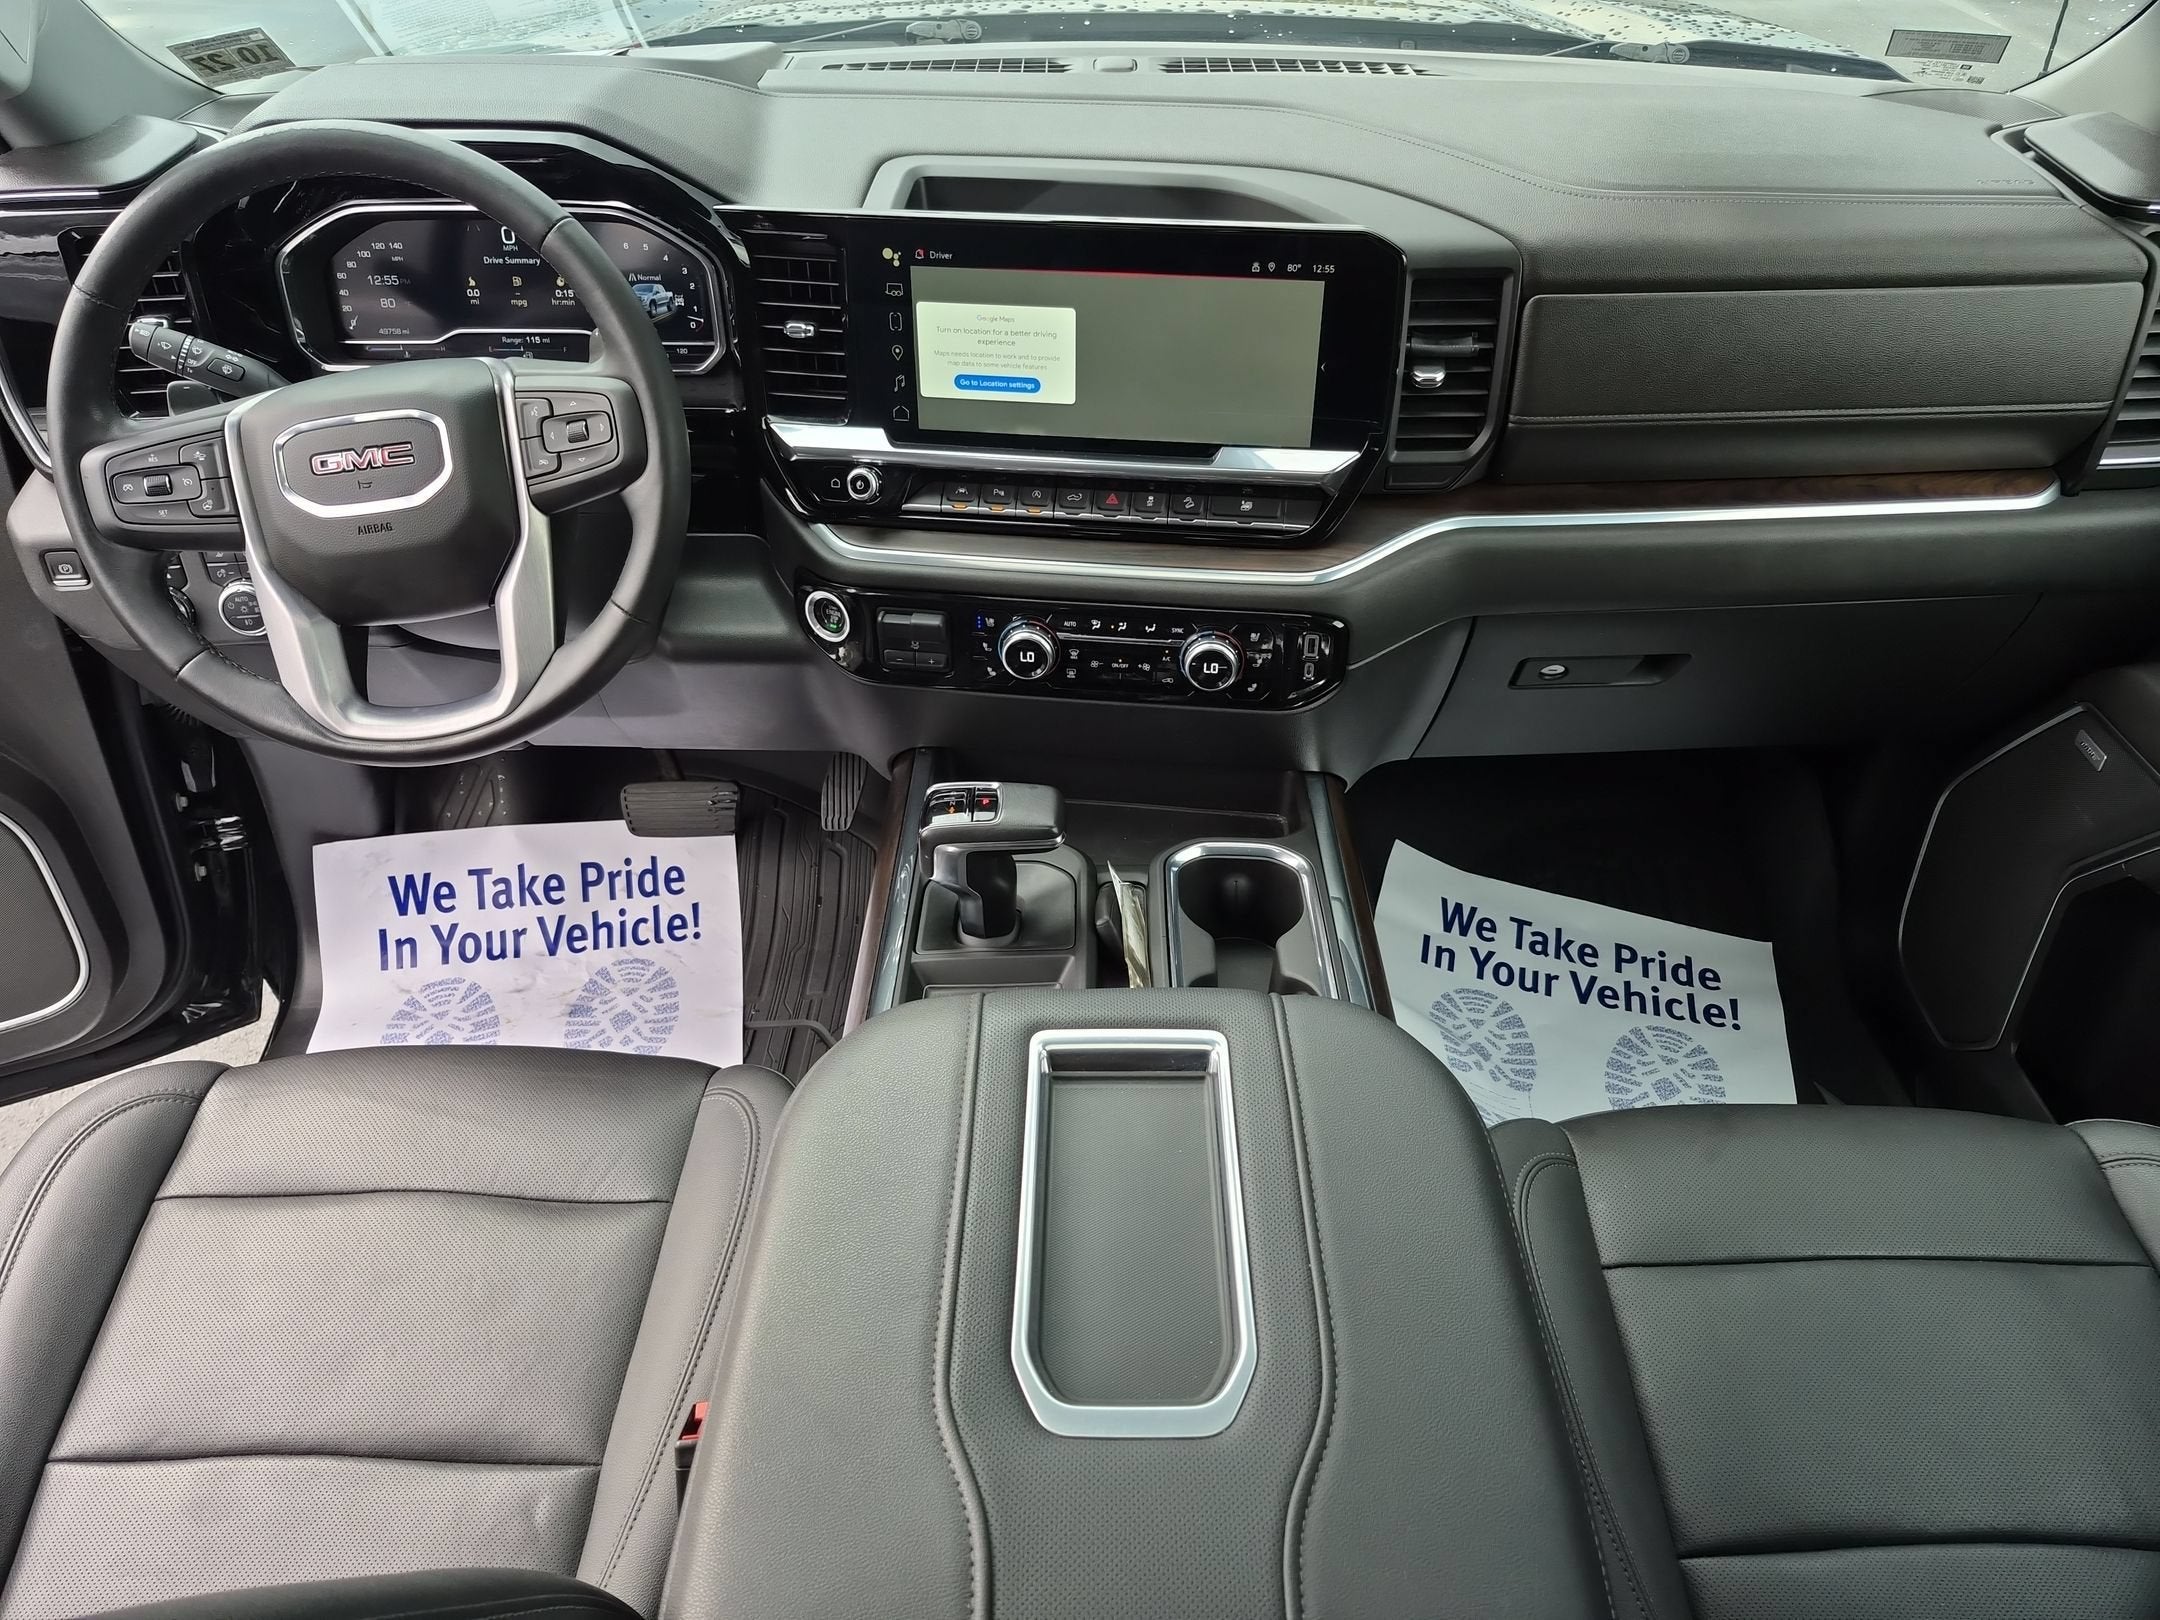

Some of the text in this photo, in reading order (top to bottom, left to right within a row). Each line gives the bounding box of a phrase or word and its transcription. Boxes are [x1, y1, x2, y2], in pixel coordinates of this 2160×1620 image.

[501, 226, 515, 244] 0
[371, 242, 386, 250] 120
[388, 242, 403, 250] 140
[643, 243, 649, 251] 5
[357, 250, 371, 258] 100
[663, 254, 669, 262] 4
[929, 250, 953, 260] Driver
[346, 261, 357, 269] 80
[483, 256, 541, 267] Drive Summary
[682, 267, 688, 275] 3
[1287, 263, 1302, 272] 80°
[1312, 264, 1335, 273] 12:55
[336, 272, 347, 280] 60
[367, 274, 400, 286] 12:55
[637, 273, 662, 281] Normal
[689, 282, 695, 290] 2
[338, 288, 349, 297] 40
[555, 289, 575, 298] 0:15
[380, 298, 396, 308] 80
[510, 299, 528, 308] mpg
[690, 321, 696, 329] 0
[936, 326, 951, 334] Turn
[963, 327, 991, 335] location
[992, 328, 1003, 336] for
[1032, 330, 1058, 340] driving
[502, 336, 524, 346] Range:
[525, 336, 540, 344] 115
[977, 338, 1016, 347] experience
[960, 378, 1036, 391] Go to Location settings
[310, 441, 415, 476] GMC
[357, 521, 394, 536] AIRBAG
[1063, 620, 1077, 628] AUTO
[1020, 651, 1035, 662] LO
[1203, 662, 1219, 674] LO
[388, 855, 686, 917] We Take Pride
[378, 901, 702, 972] In Your Vehicle!
[1440, 896, 1722, 991] We Take Pride
[1420, 934, 1742, 1032] In Your Vehicle!
